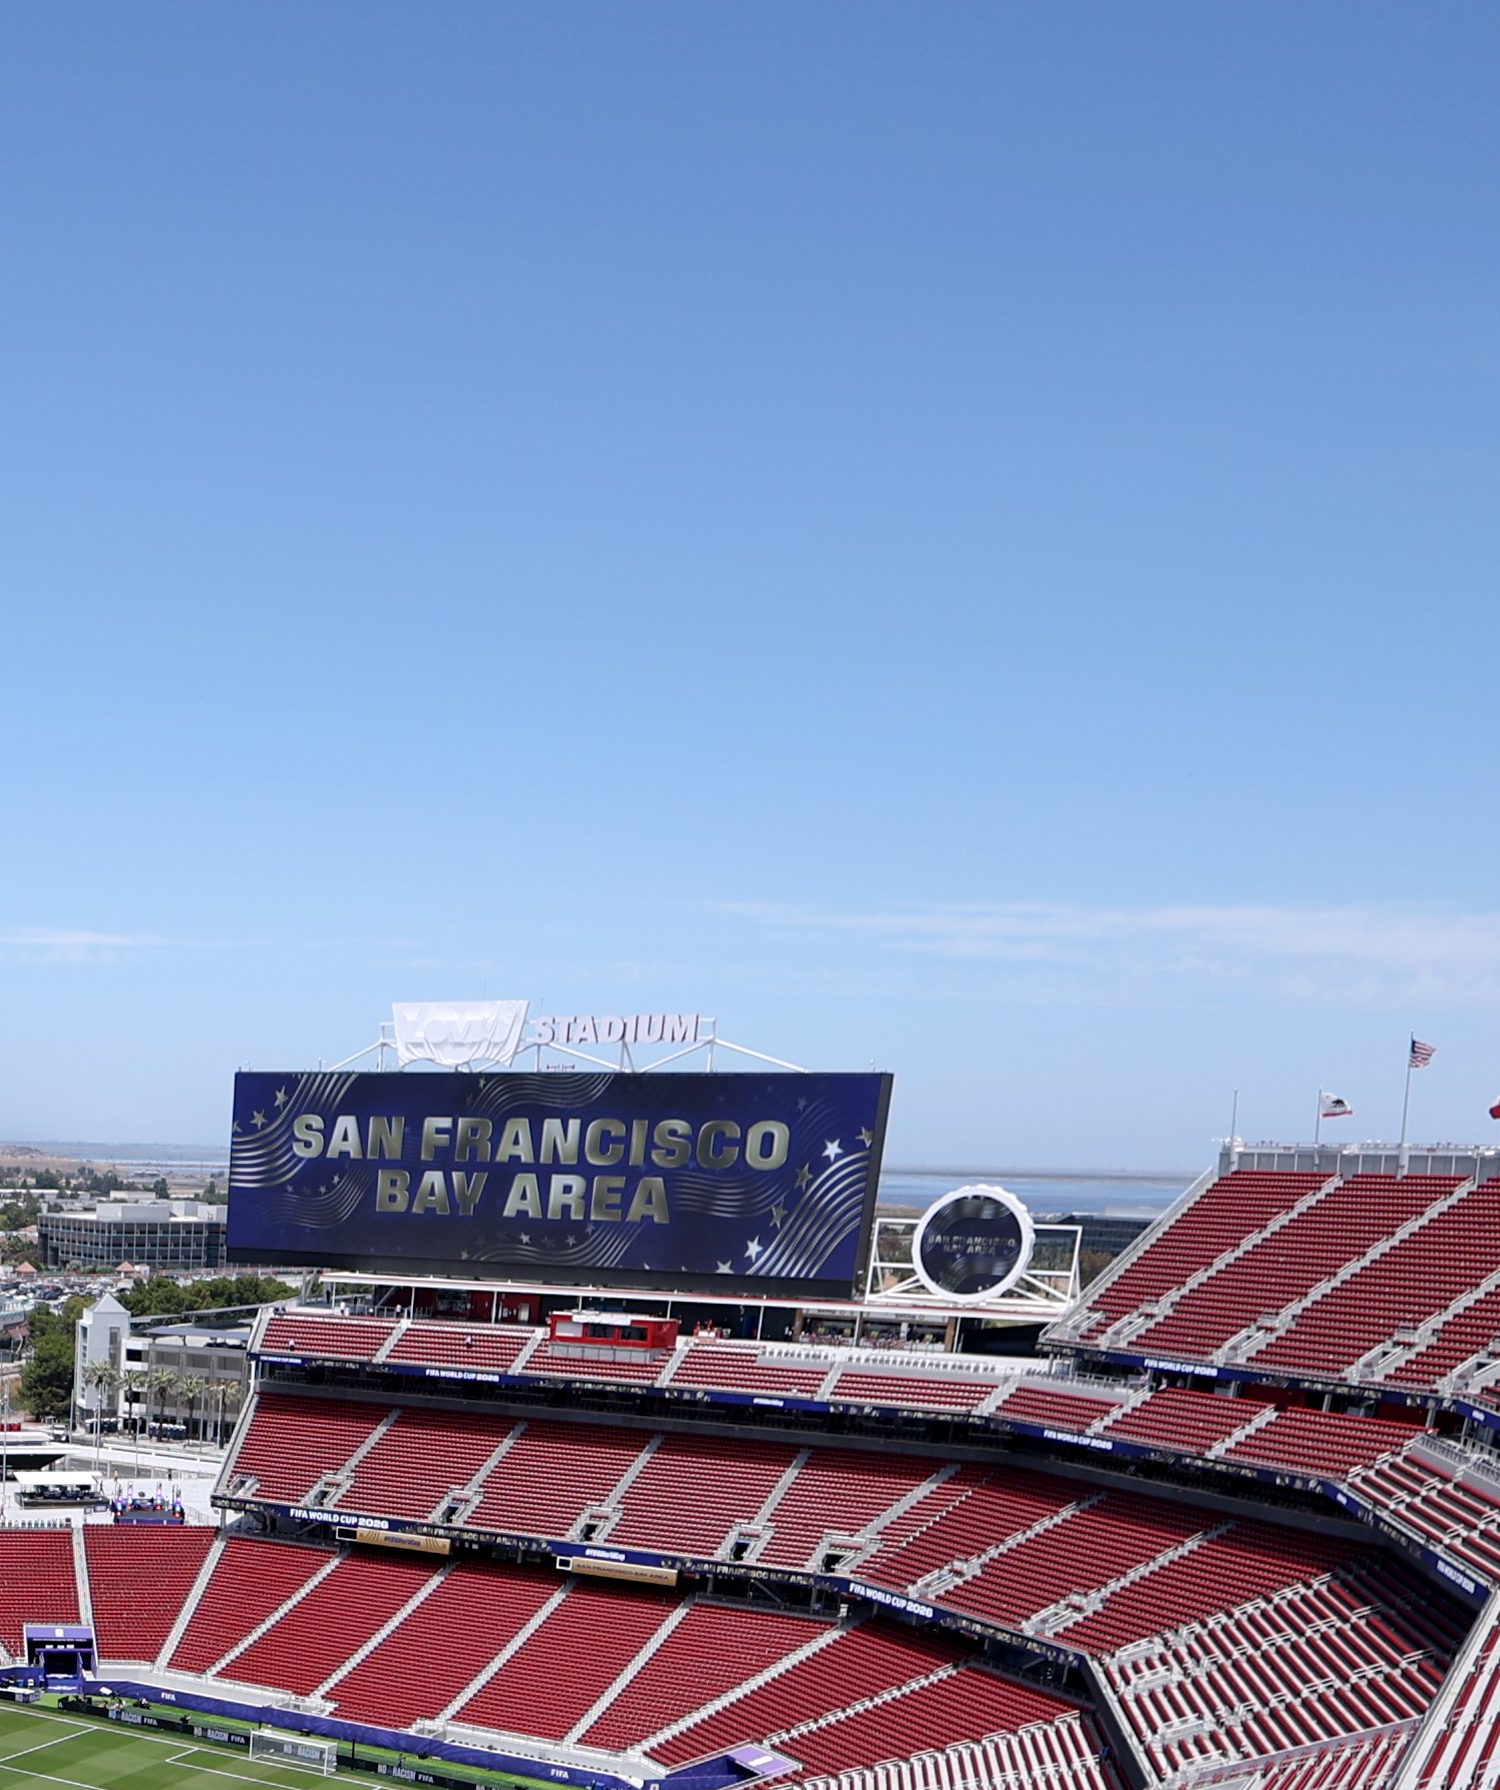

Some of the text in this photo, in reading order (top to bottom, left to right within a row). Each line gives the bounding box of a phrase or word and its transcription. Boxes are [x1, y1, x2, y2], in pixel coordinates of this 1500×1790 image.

[536, 1014, 700, 1043] STADIUM
[292, 1113, 791, 1171] SAN FRANCISCO
[376, 1169, 670, 1224] BAY AREA
[290, 1508, 389, 1530] FIFA WORLD CUP 2026
[850, 1582, 934, 1618] FIFA WORLD CUP 2026
[161, 1692, 176, 1702] FIFA
[144, 1716, 158, 1727] FIFA
[231, 1734, 246, 1744] FIFA
[378, 1764, 434, 1784] NO RACISM FIFA
[550, 1768, 570, 1780] FIFA
